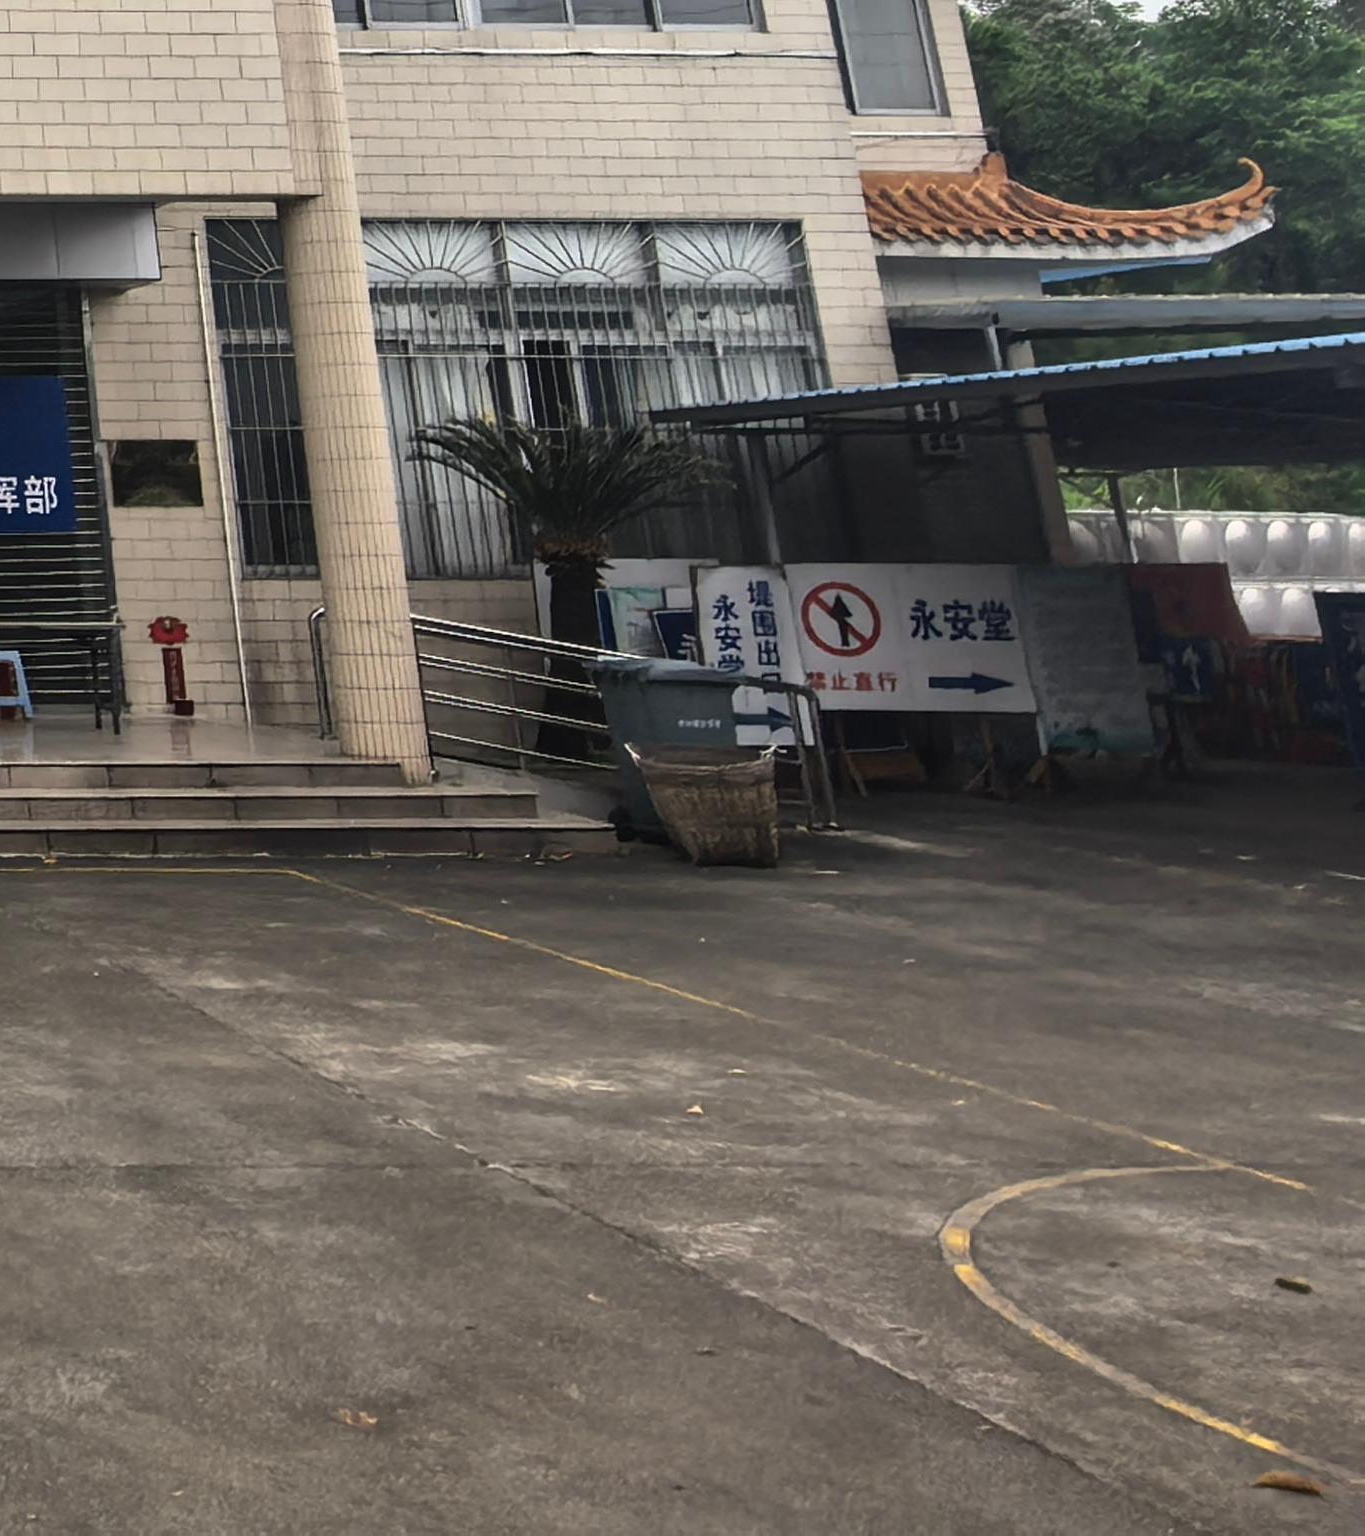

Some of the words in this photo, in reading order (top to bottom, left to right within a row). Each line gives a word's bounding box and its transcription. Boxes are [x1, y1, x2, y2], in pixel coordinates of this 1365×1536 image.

[910, 599, 1016, 641] 永安堂
[806, 668, 897, 693] 禁止直行
